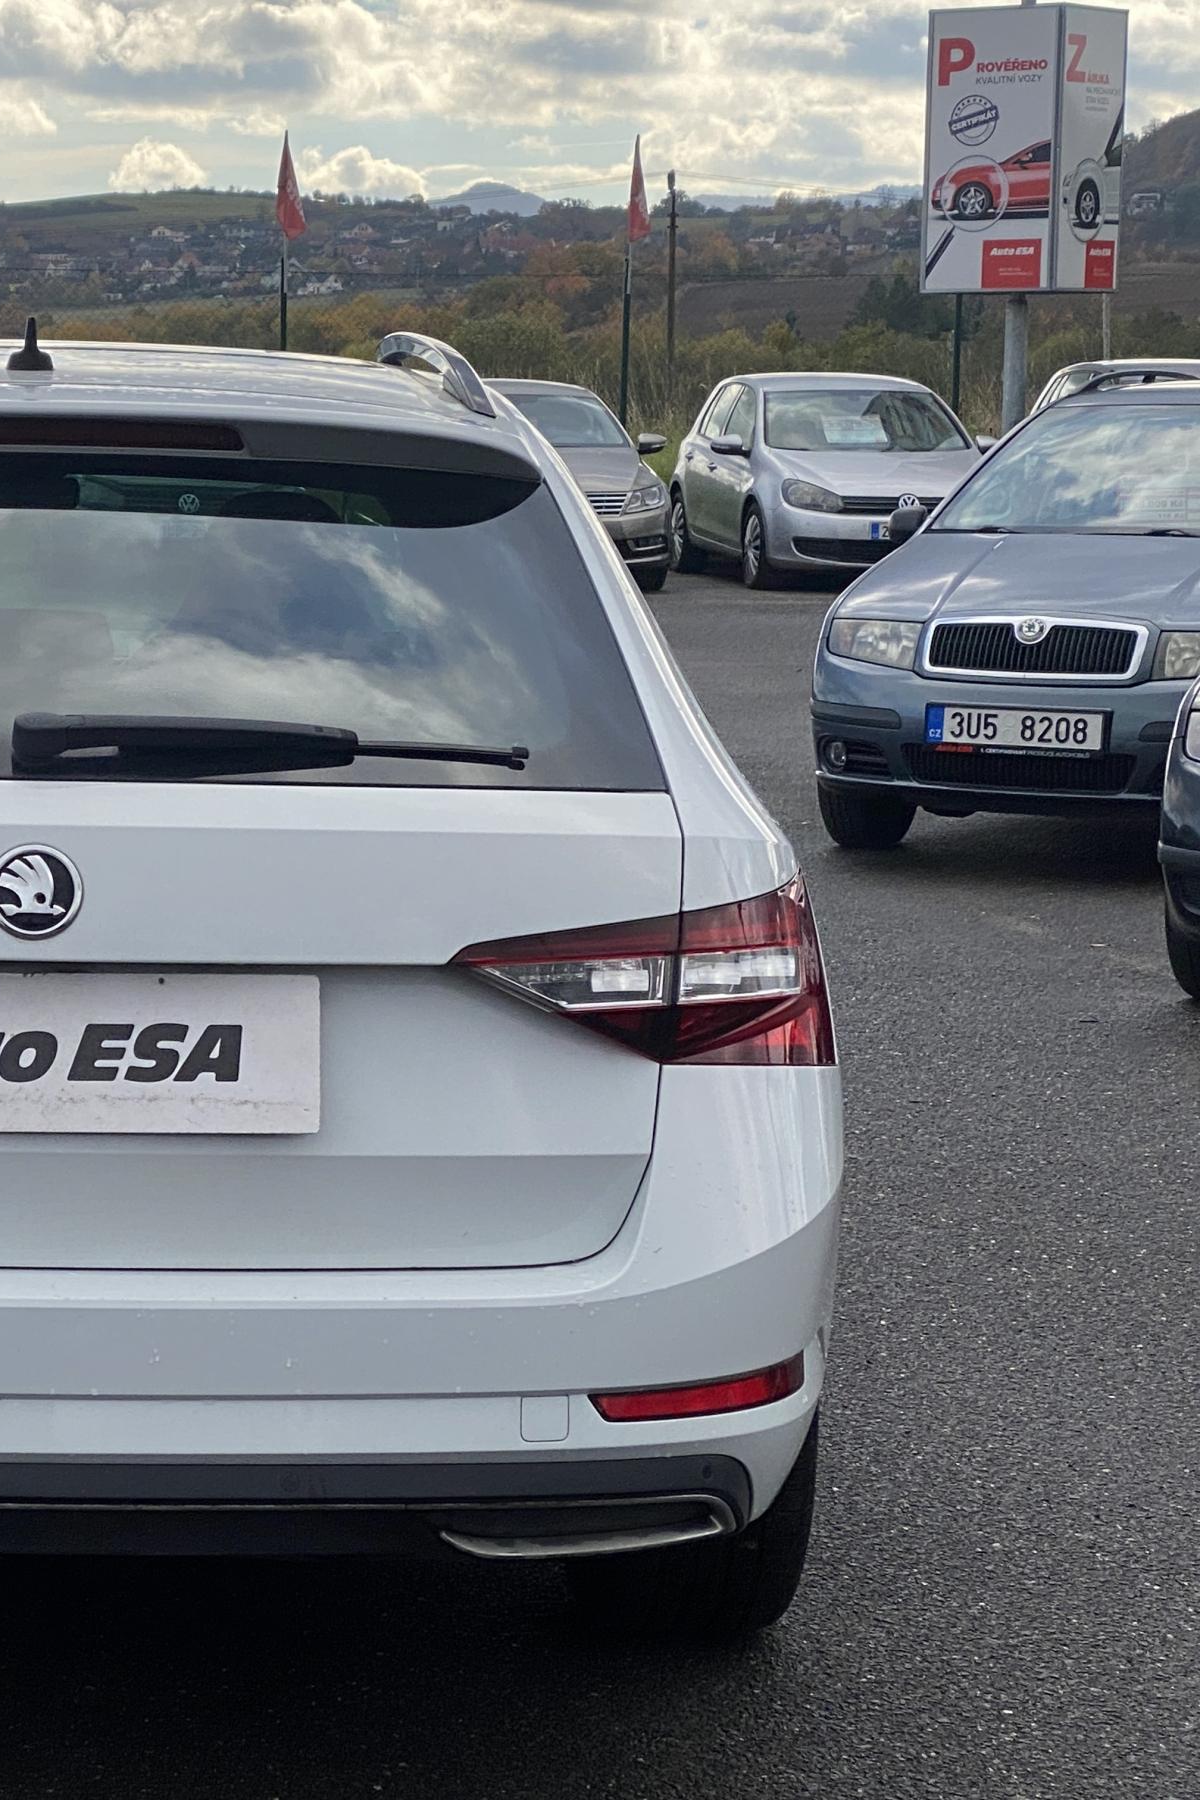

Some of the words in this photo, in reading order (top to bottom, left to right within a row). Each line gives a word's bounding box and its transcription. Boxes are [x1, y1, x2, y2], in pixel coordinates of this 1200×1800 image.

[975, 73, 1016, 85] KVALITNÍ
[1017, 74, 1043, 83] VOZY
[929, 729, 942, 738] CZ
[950, 712, 998, 740] 3U5
[1020, 715, 1088, 745] 8208
[67, 1022, 243, 1083] ESA
